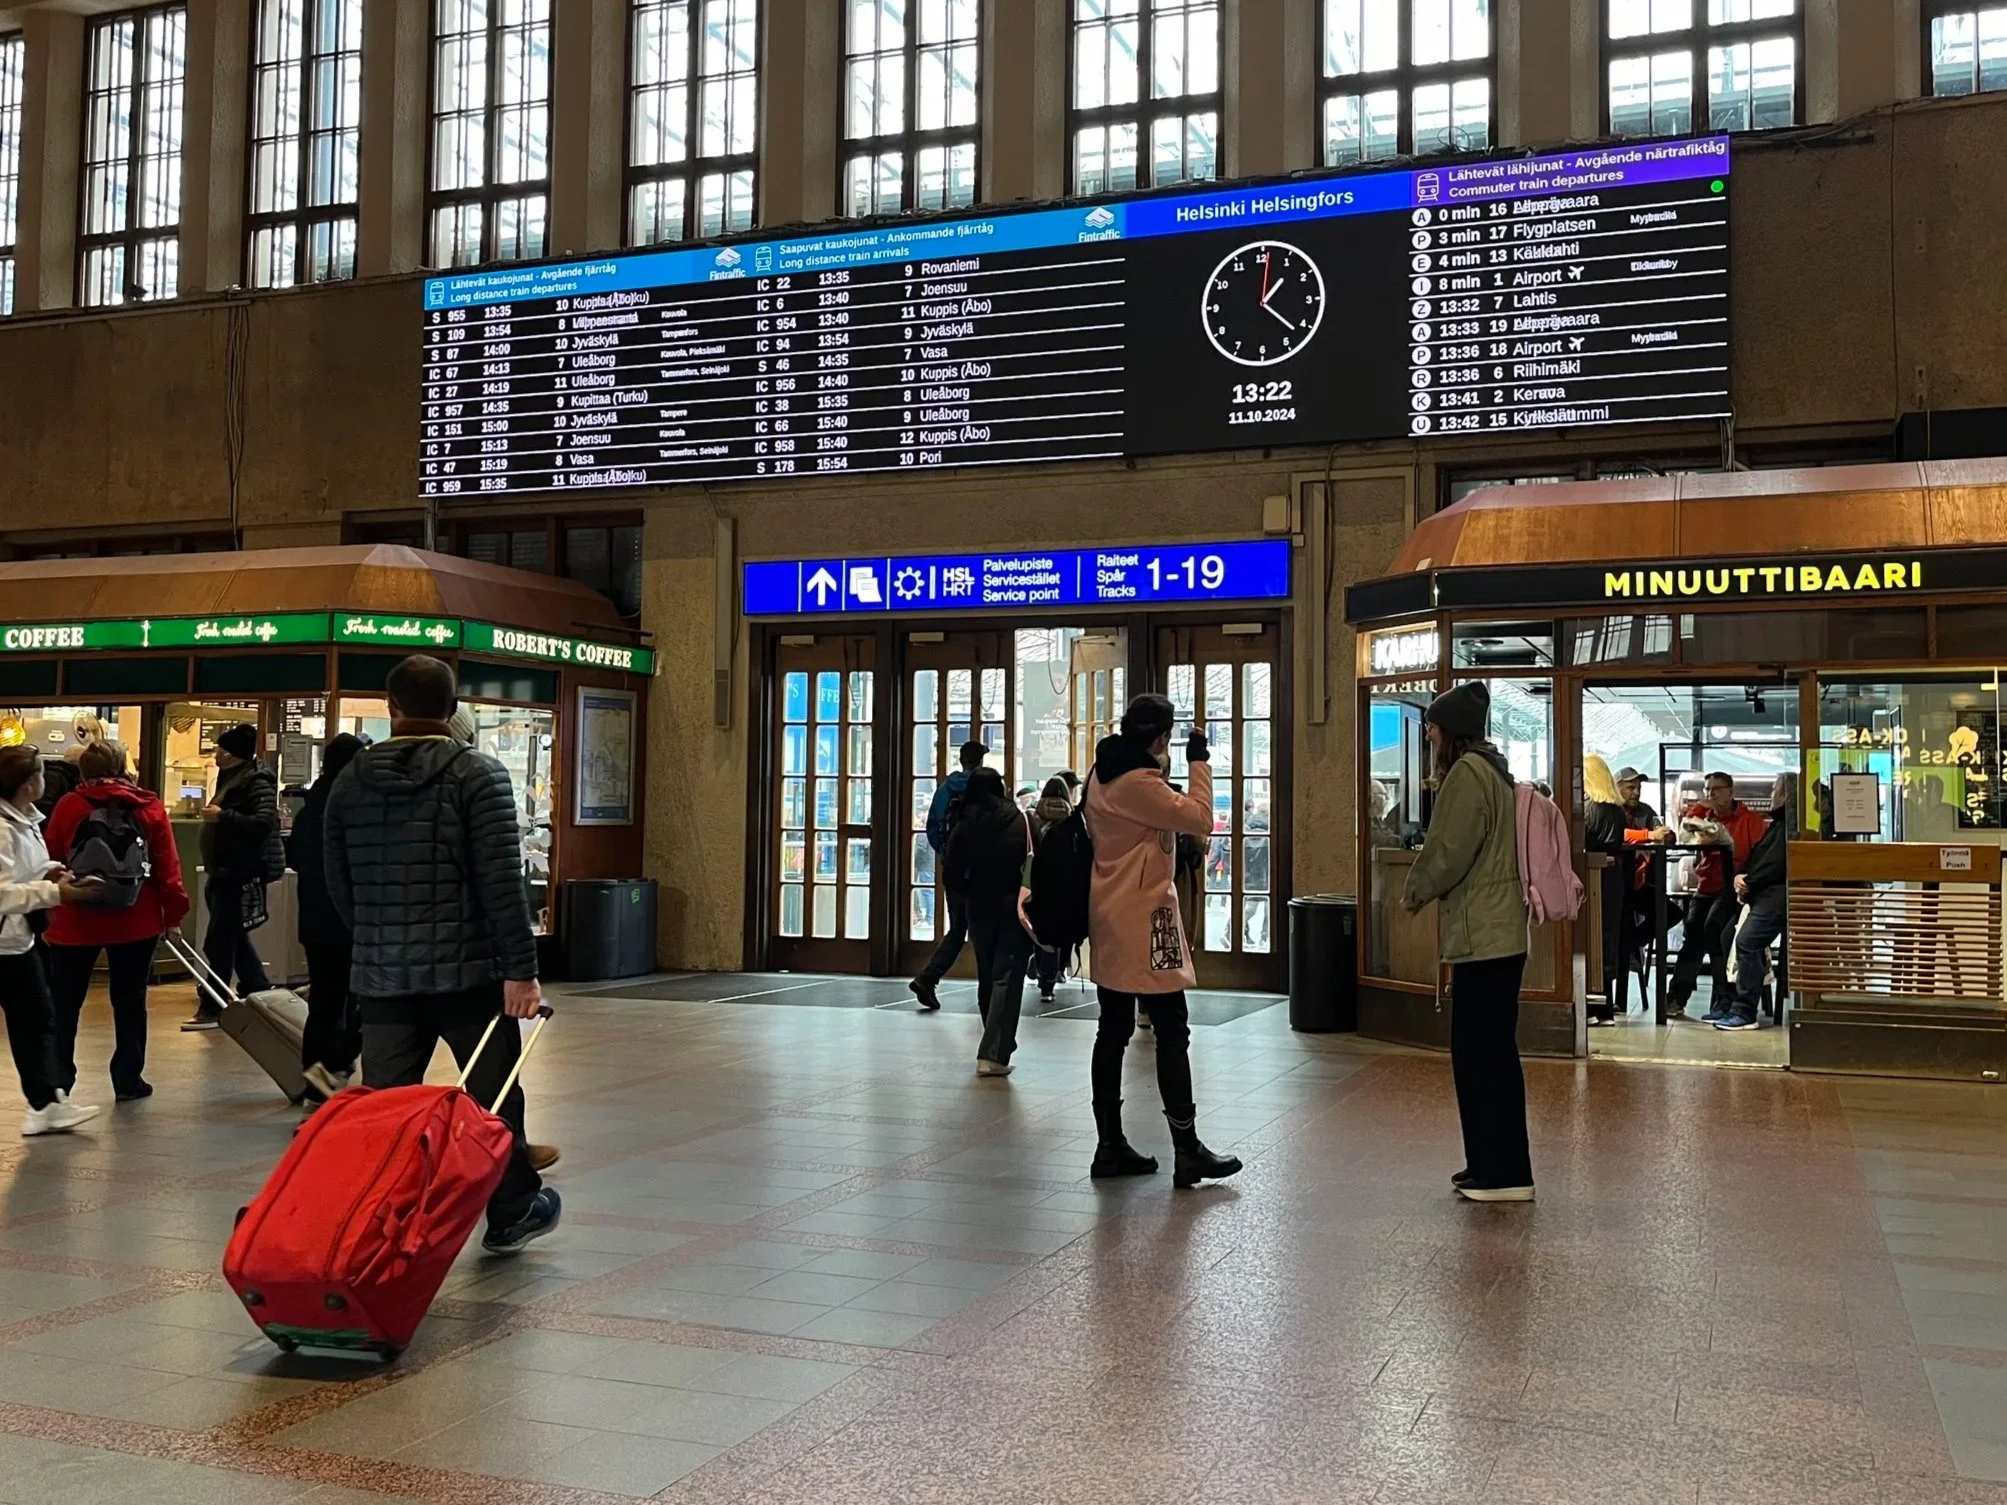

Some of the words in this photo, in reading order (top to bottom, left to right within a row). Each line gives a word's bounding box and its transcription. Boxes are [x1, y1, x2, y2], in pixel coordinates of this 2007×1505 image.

[1449, 166, 1504, 181] Lähtevät
[1507, 160, 1563, 175] lähijunat
[1575, 151, 1642, 168] Avgående
[1646, 140, 1725, 160] närtrafiktåg
[1449, 182, 1515, 197] Commuter
[1519, 178, 1548, 190] train
[1551, 171, 1624, 188] departures
[1177, 201, 1244, 221] Helsinki
[1252, 192, 1353, 213] Helsingfors
[1439, 208, 1448, 221] 0
[1452, 205, 1480, 220] min
[1489, 202, 1507, 217] 16
[780, 242, 823, 254] Saapuvat
[825, 236, 878, 249] kaukojunat
[887, 227, 954, 242] Ankommande
[957, 223, 993, 237] fjärrtåg
[1078, 229, 1120, 243] Fintraffic
[1438, 231, 1448, 244] 3
[1451, 228, 1480, 243] min
[1489, 225, 1508, 240] 17
[1513, 219, 1596, 239] Flygplatsen
[780, 259, 803, 269] Long
[805, 254, 846, 266] distance
[848, 252, 870, 261] train
[873, 247, 909, 258] arrivals
[1439, 254, 1449, 267] 4
[1452, 251, 1480, 266] min
[1489, 249, 1507, 263] 13
[451, 277, 486, 289] Lähtevät
[488, 273, 533, 285] kaukojunat
[541, 267, 582, 280] Avgående
[584, 263, 616, 276] fjärrtåg
[776, 276, 791, 289] 22
[819, 270, 850, 285] 13:35
[921, 257, 979, 275] Rovaniemi
[1439, 277, 1448, 290] 8
[1451, 274, 1480, 290] min
[1512, 269, 1562, 286] Airport
[451, 294, 471, 303] Long
[473, 290, 508, 300] distance
[510, 287, 529, 296] train
[531, 282, 577, 294] departures
[776, 297, 784, 310] 6
[818, 291, 849, 306] 13:40
[921, 282, 967, 296] Joensuu
[1440, 298, 1480, 314] 13:32
[1513, 291, 1557, 307] Lahtis
[447, 309, 466, 322] 955
[484, 304, 512, 318] 13:35
[556, 298, 569, 311] 10
[776, 317, 797, 330] 954
[818, 312, 849, 326] 13:40
[901, 306, 916, 319] 11
[921, 302, 959, 318] Kuppis
[961, 298, 992, 316] (Åbo)
[447, 328, 465, 341] 109
[483, 323, 511, 337] 13:54
[775, 338, 790, 351] 94
[818, 332, 849, 347] 13:54
[920, 322, 974, 340] Jyväskylä
[1440, 321, 1480, 337] 13:33
[1489, 319, 1508, 333] 19
[446, 348, 459, 360] 87
[483, 343, 511, 356] 14:00
[555, 337, 568, 350] 10
[572, 333, 619, 350] Jyväskylä
[1439, 344, 1480, 360] 13:36
[1489, 342, 1507, 356] 18
[1512, 340, 1563, 357] Airport
[446, 366, 459, 379] 67
[483, 362, 510, 376] 14:13
[572, 353, 616, 368] Uleåborg
[776, 358, 790, 371] 46
[818, 353, 849, 367] 14:35
[920, 346, 948, 358] Vasa
[775, 378, 796, 391] 956
[818, 374, 848, 388] 14:40
[900, 368, 915, 382] 10
[920, 365, 958, 381] Kuppis
[960, 361, 991, 379] (Åbo)
[1439, 368, 1480, 383] 13:36
[1513, 359, 1580, 378] Riihimäki
[445, 385, 458, 398] 27
[482, 381, 510, 395] 14:19
[554, 376, 567, 389] 11
[571, 373, 615, 387] Uleåborg
[1232, 381, 1292, 403] 13:22
[444, 404, 463, 417] 957
[482, 400, 509, 414] 14:35
[571, 393, 611, 408] Kupittaa
[612, 389, 648, 406] (Turku)
[775, 399, 789, 412] 38
[817, 394, 848, 409] 15:35
[920, 385, 970, 401] Uleåborg
[1439, 391, 1480, 407] 13:41
[444, 423, 463, 435] 151
[481, 419, 509, 433] 15:00
[553, 415, 567, 428] 10
[570, 411, 618, 428] Jyväskylä
[774, 419, 789, 432] 66
[817, 415, 848, 429] 15:40
[920, 407, 970, 422] Uleåborg
[1229, 408, 1296, 424] 11.10.2024
[1439, 415, 1480, 430] 13:42
[1489, 412, 1507, 426] 15
[444, 443, 451, 454] 7
[480, 438, 508, 452] 15:13
[570, 434, 611, 446] Joensuu
[774, 439, 795, 453] 958
[817, 436, 848, 450] 15:40
[899, 431, 914, 444] 12
[919, 428, 957, 445] Kuppis
[959, 425, 990, 443] (Åbo)
[443, 461, 456, 473] 47
[480, 458, 508, 471] 15:19
[569, 454, 594, 465] Vasa
[774, 460, 795, 473] 178
[816, 456, 848, 470] 15:54
[899, 452, 914, 465] 10
[919, 450, 942, 464] Pori
[442, 480, 461, 492] 959
[479, 477, 507, 490] 15:35
[552, 474, 565, 486] 11
[984, 558, 1052, 572] Palvelupiste
[1097, 554, 1138, 566] Raiteet
[943, 567, 975, 581] HSL
[983, 572, 1060, 586] Servicestället
[1097, 569, 1125, 584] Spår
[1147, 556, 1224, 590] 1-19
[1606, 562, 1920, 596] MINUUTTIBAARI
[943, 583, 974, 596] HRT
[983, 589, 1026, 602] Service
[1029, 588, 1059, 603] point
[1097, 583, 1135, 597] Tracks
[5, 627, 83, 648] COFFEE
[493, 629, 571, 659] ROBERT'S
[576, 643, 632, 668] COFFEE
